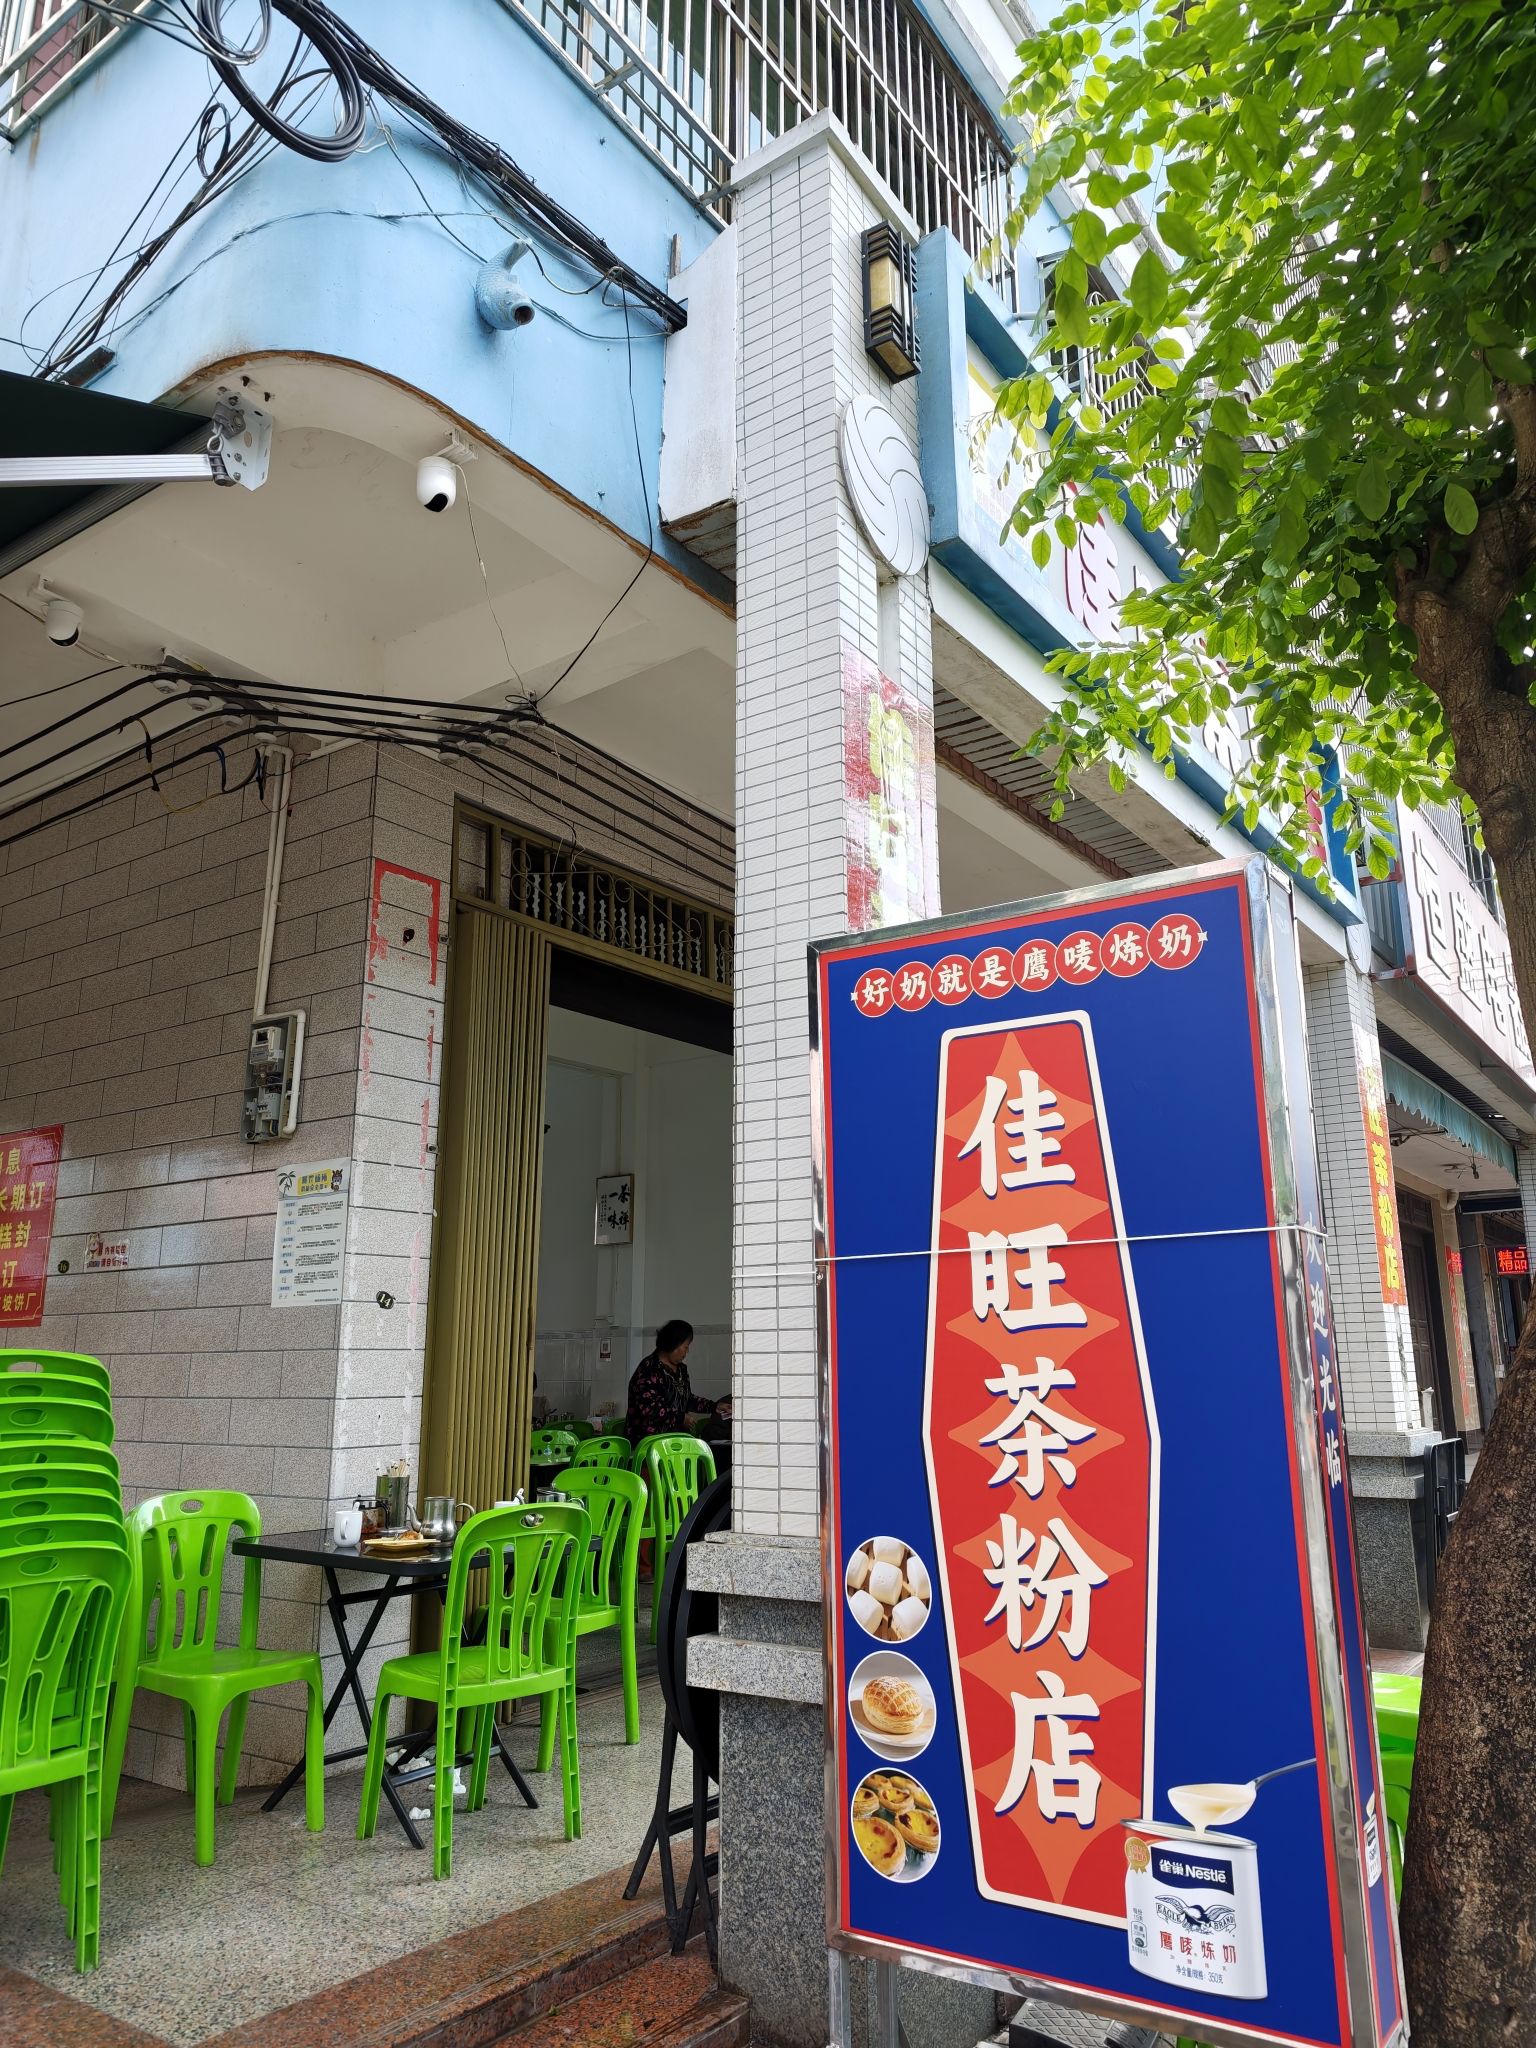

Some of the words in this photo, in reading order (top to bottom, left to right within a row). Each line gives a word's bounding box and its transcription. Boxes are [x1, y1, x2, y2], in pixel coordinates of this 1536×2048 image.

[861, 924, 1192, 1009] 好奶就是鹰唛炼奶
[1366, 1065, 1399, 1290] 旺茶粉店
[2, 1260, 18, 1288] 订
[1497, 1249, 1528, 1272] 精品
[0, 1292, 37, 1312] 坡饼厂
[380, 1293, 392, 1308] 14
[1303, 1210, 1342, 1489] 欢迎光临
[957, 1069, 1109, 1829] 佳旺茶粉店
[1159, 1858, 1184, 1876] 雀巢
[1156, 1904, 1182, 1923] EAGLE
[1213, 1914, 1235, 1931] BRAND
[1160, 1930, 1237, 1964] 鹰唛炼奶
